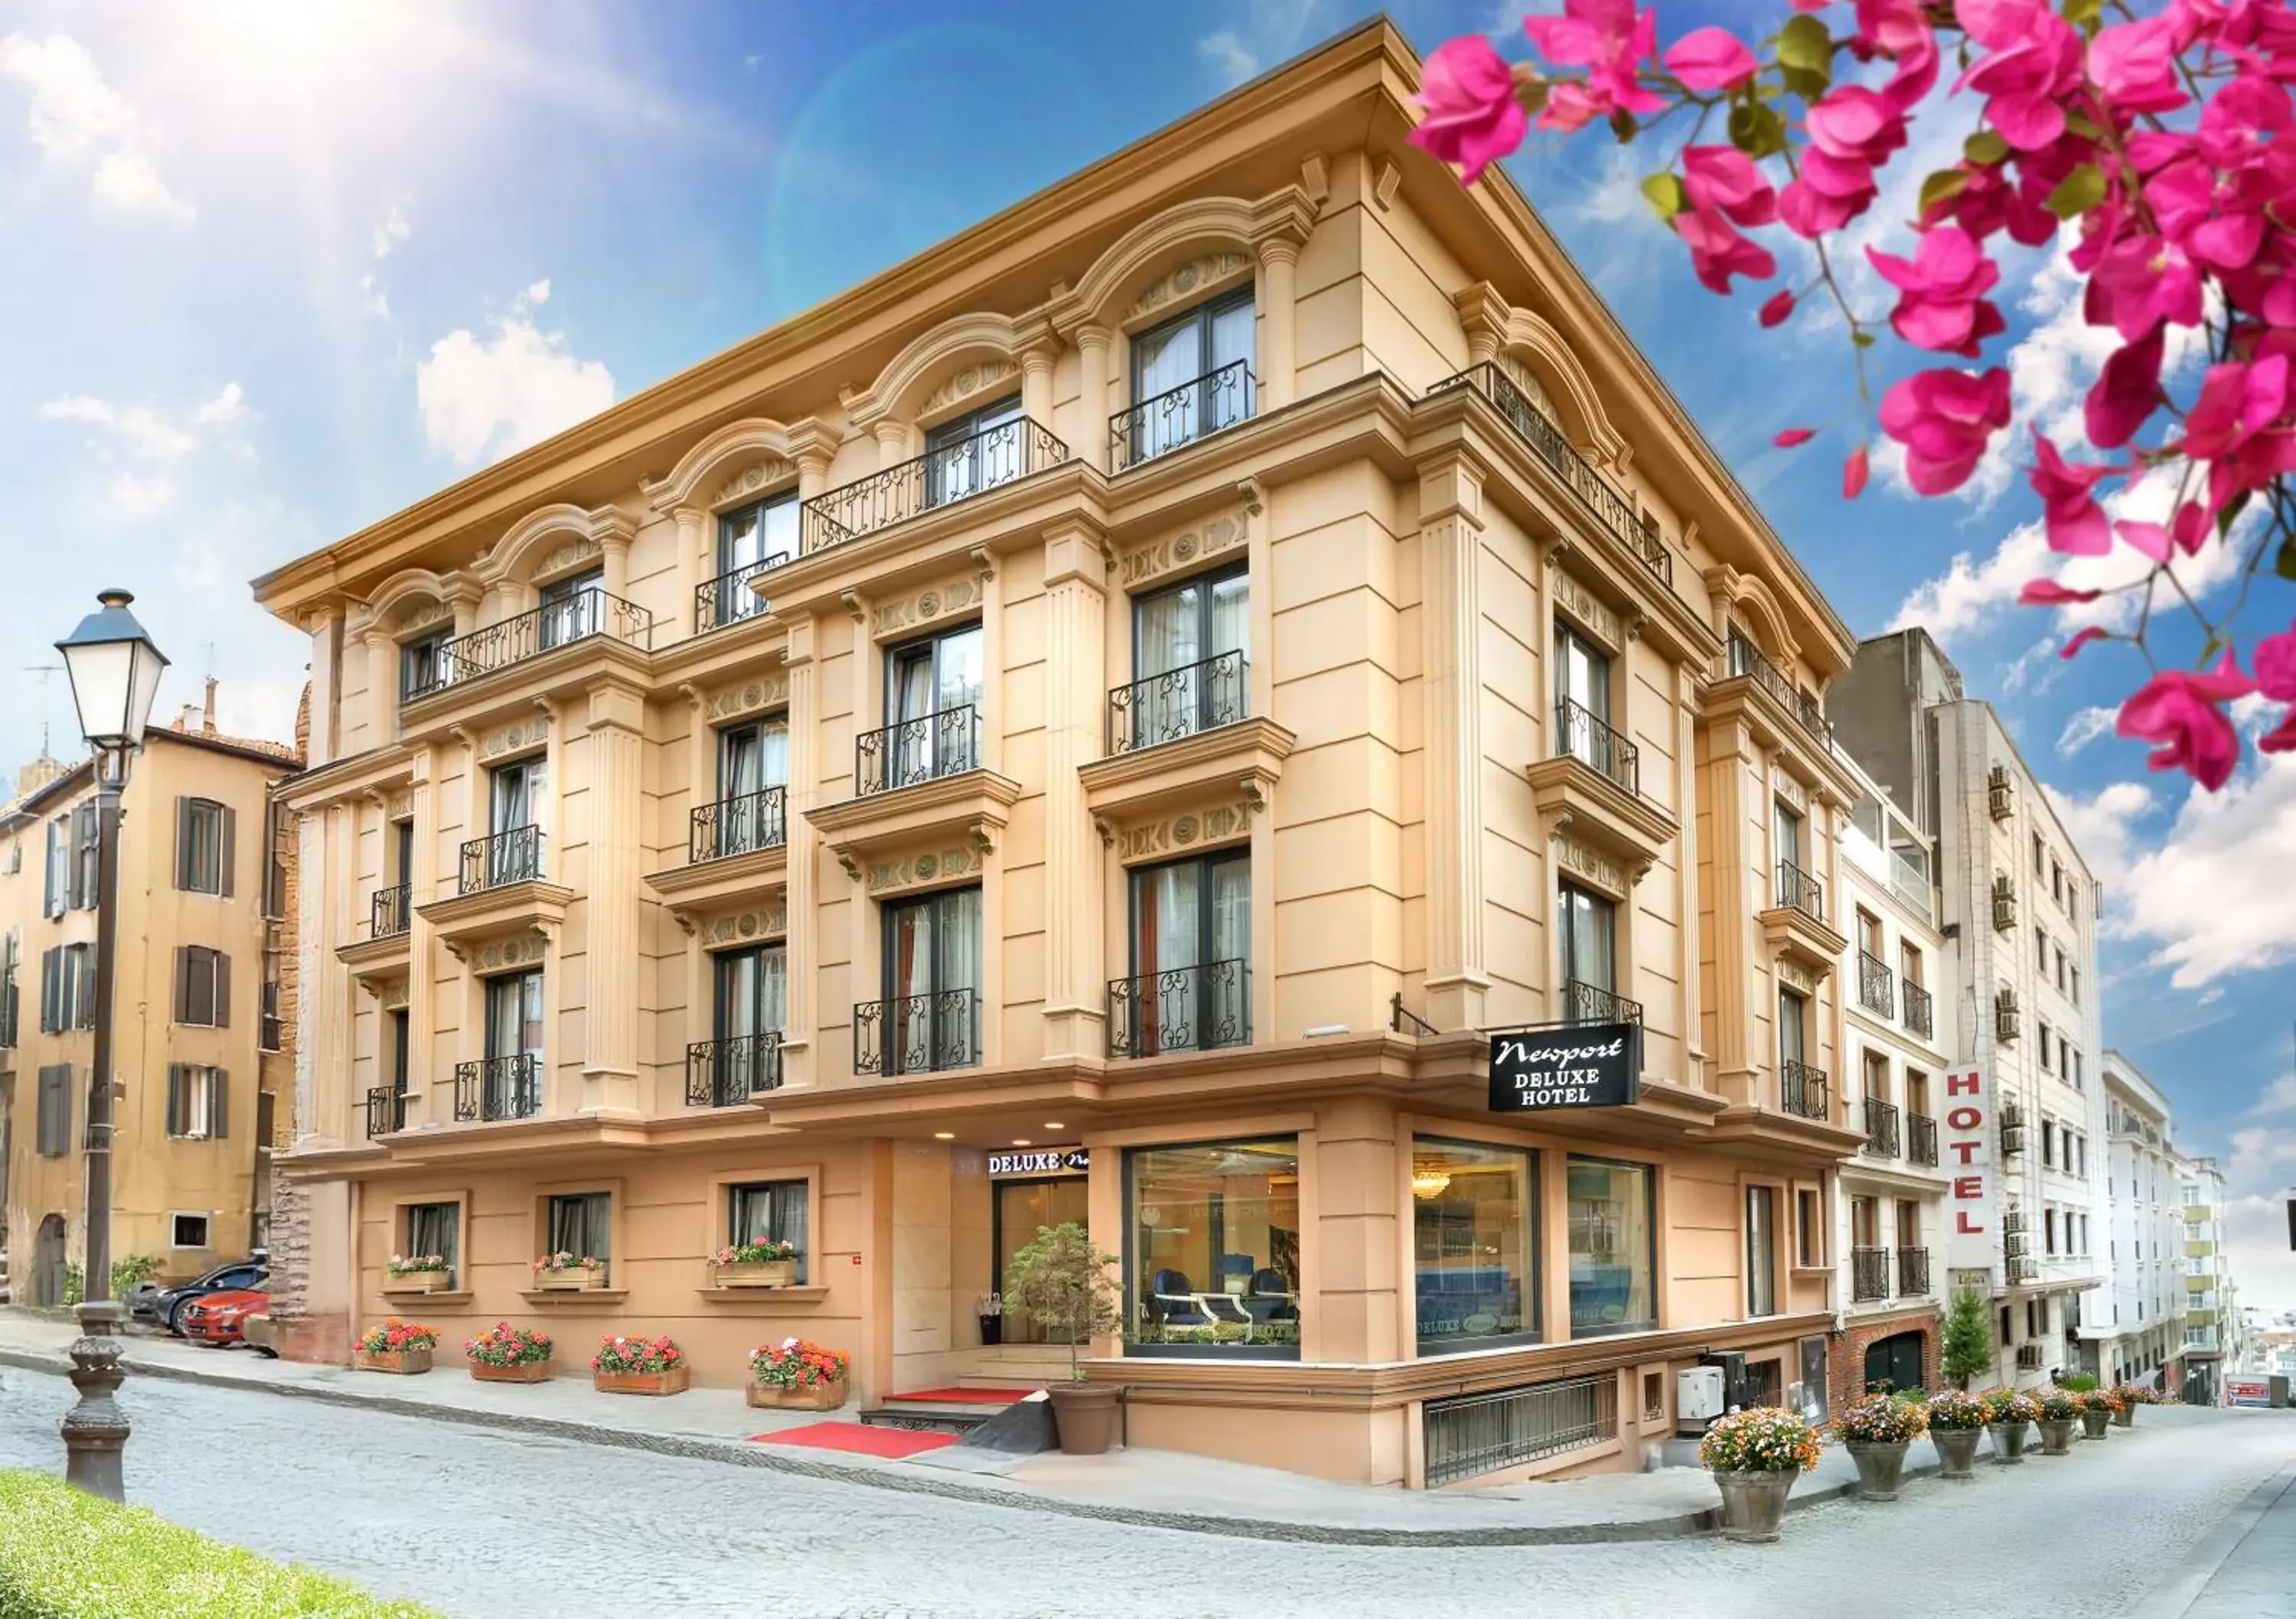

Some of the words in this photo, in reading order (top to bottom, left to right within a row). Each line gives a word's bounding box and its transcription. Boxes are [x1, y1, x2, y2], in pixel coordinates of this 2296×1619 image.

[1495, 1038, 1623, 1069] Newport
[1515, 1069, 1600, 1089] DELUXE
[1521, 1087, 1591, 1106] HOTEL
[989, 1153, 1059, 1173] DELUXE
[1947, 1072, 1984, 1234] HOTEL
